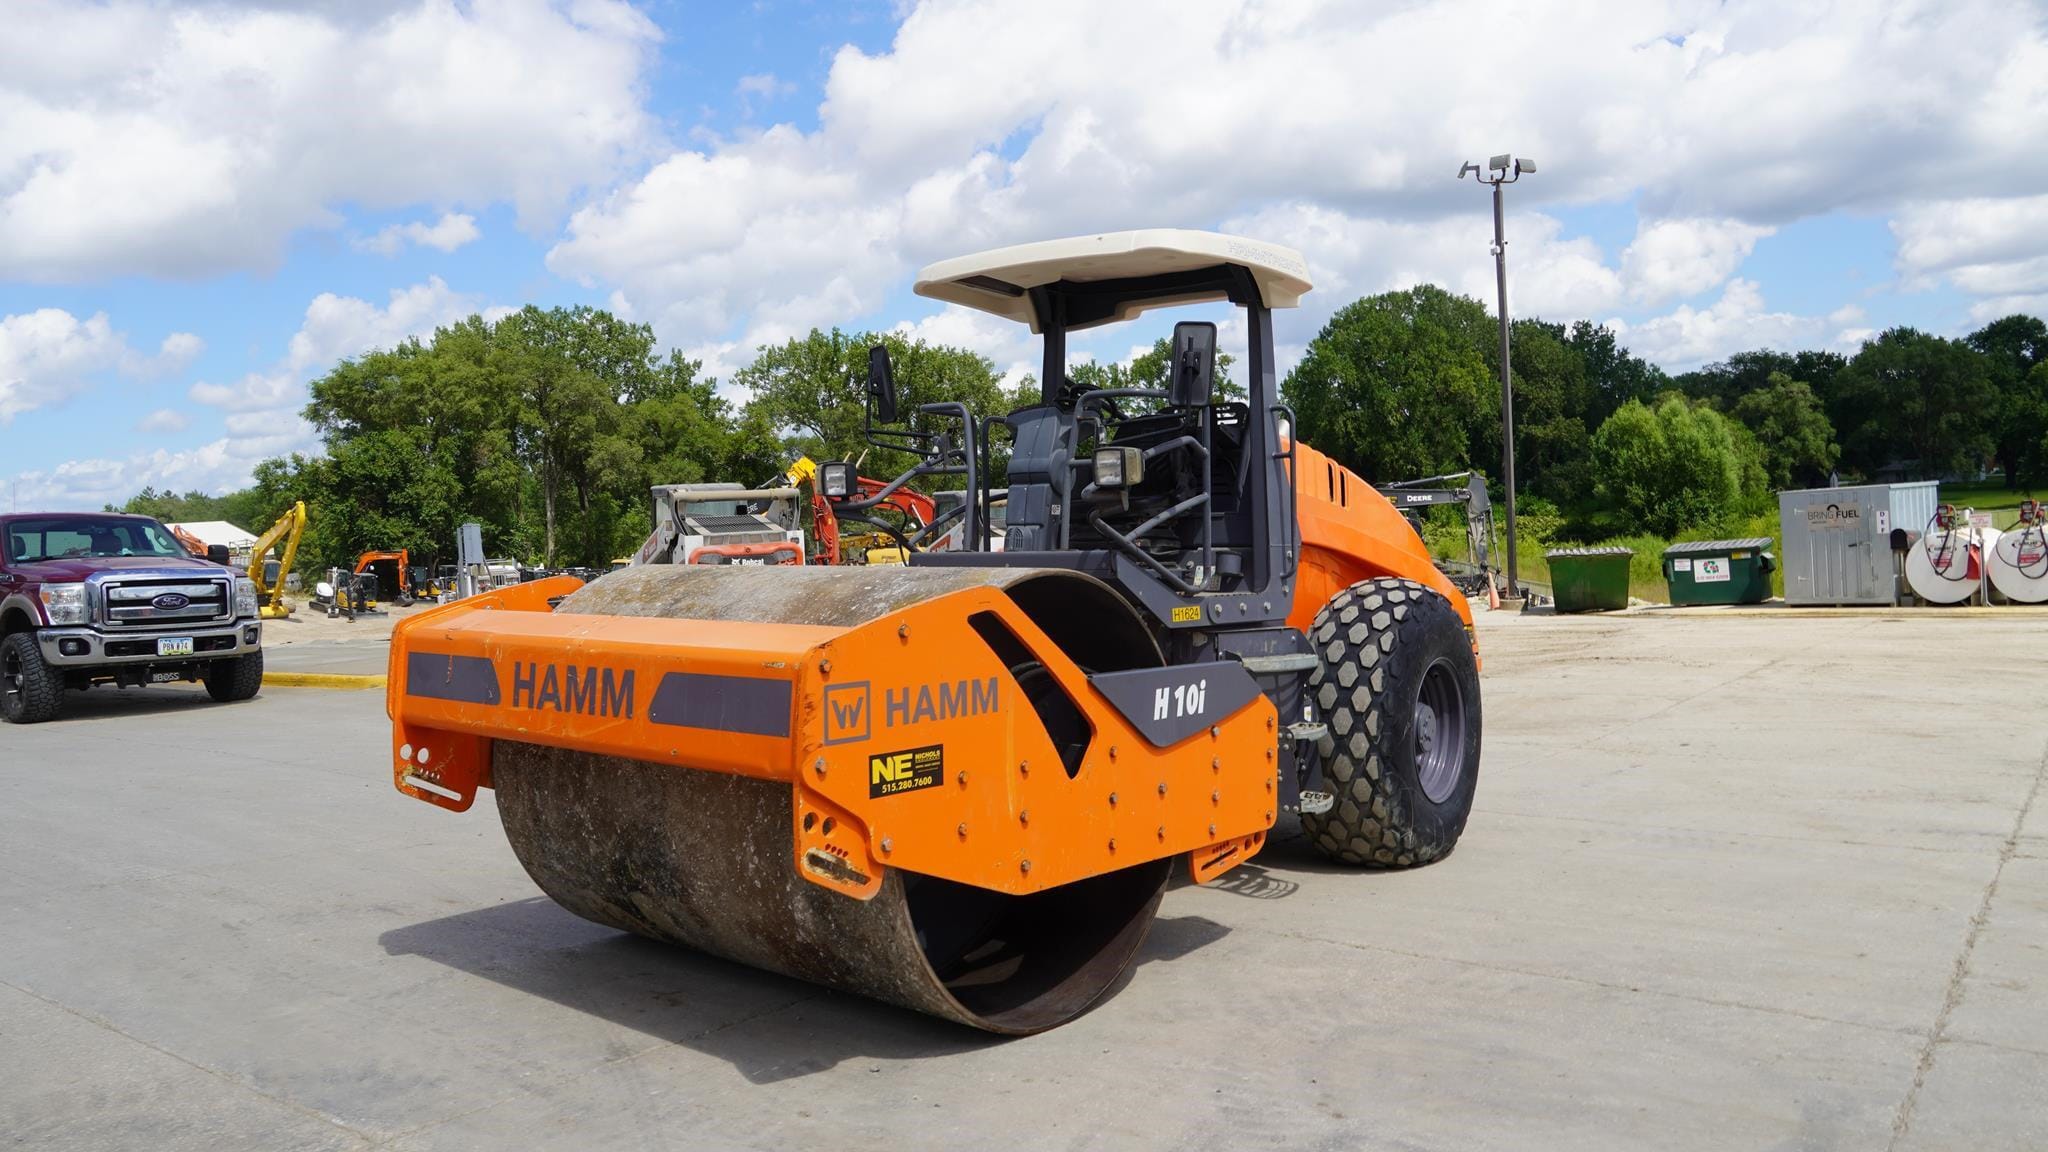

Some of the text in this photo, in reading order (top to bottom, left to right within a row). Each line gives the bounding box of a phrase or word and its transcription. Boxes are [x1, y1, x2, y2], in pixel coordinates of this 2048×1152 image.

[1808, 510, 1860, 520] BRING FUEL
[742, 558, 765, 566] Bobcat
[161, 597, 182, 606] Ford
[1174, 607, 1199, 621] H1624
[157, 673, 180, 681] BOSS
[512, 661, 635, 719] HAMM
[886, 677, 998, 727] HAMM
[1154, 679, 1206, 720] H 10i
[872, 753, 913, 784] NE
[882, 776, 932, 793] 515.280.7600
